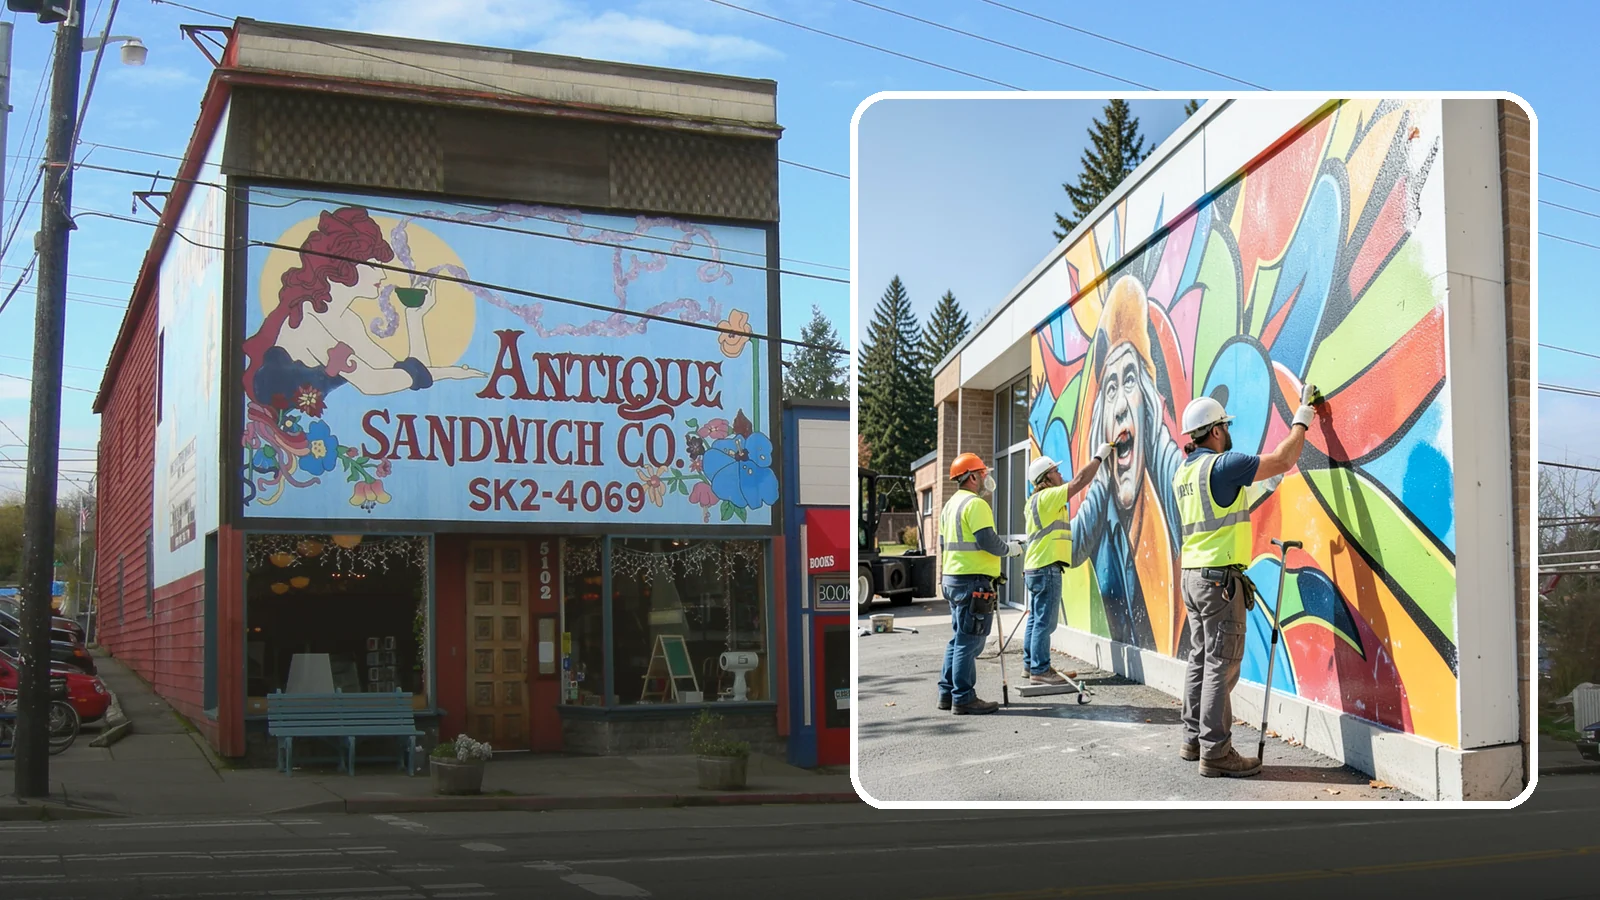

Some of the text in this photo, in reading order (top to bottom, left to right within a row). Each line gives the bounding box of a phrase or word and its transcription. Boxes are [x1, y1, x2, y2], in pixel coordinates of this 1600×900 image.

[476, 329, 723, 420] ANTIQUE
[361, 408, 685, 469] SANDWICH CO.
[468, 477, 646, 513] SK2-4069
[540, 541, 551, 600] 5102
[809, 554, 835, 569] BOOKS
